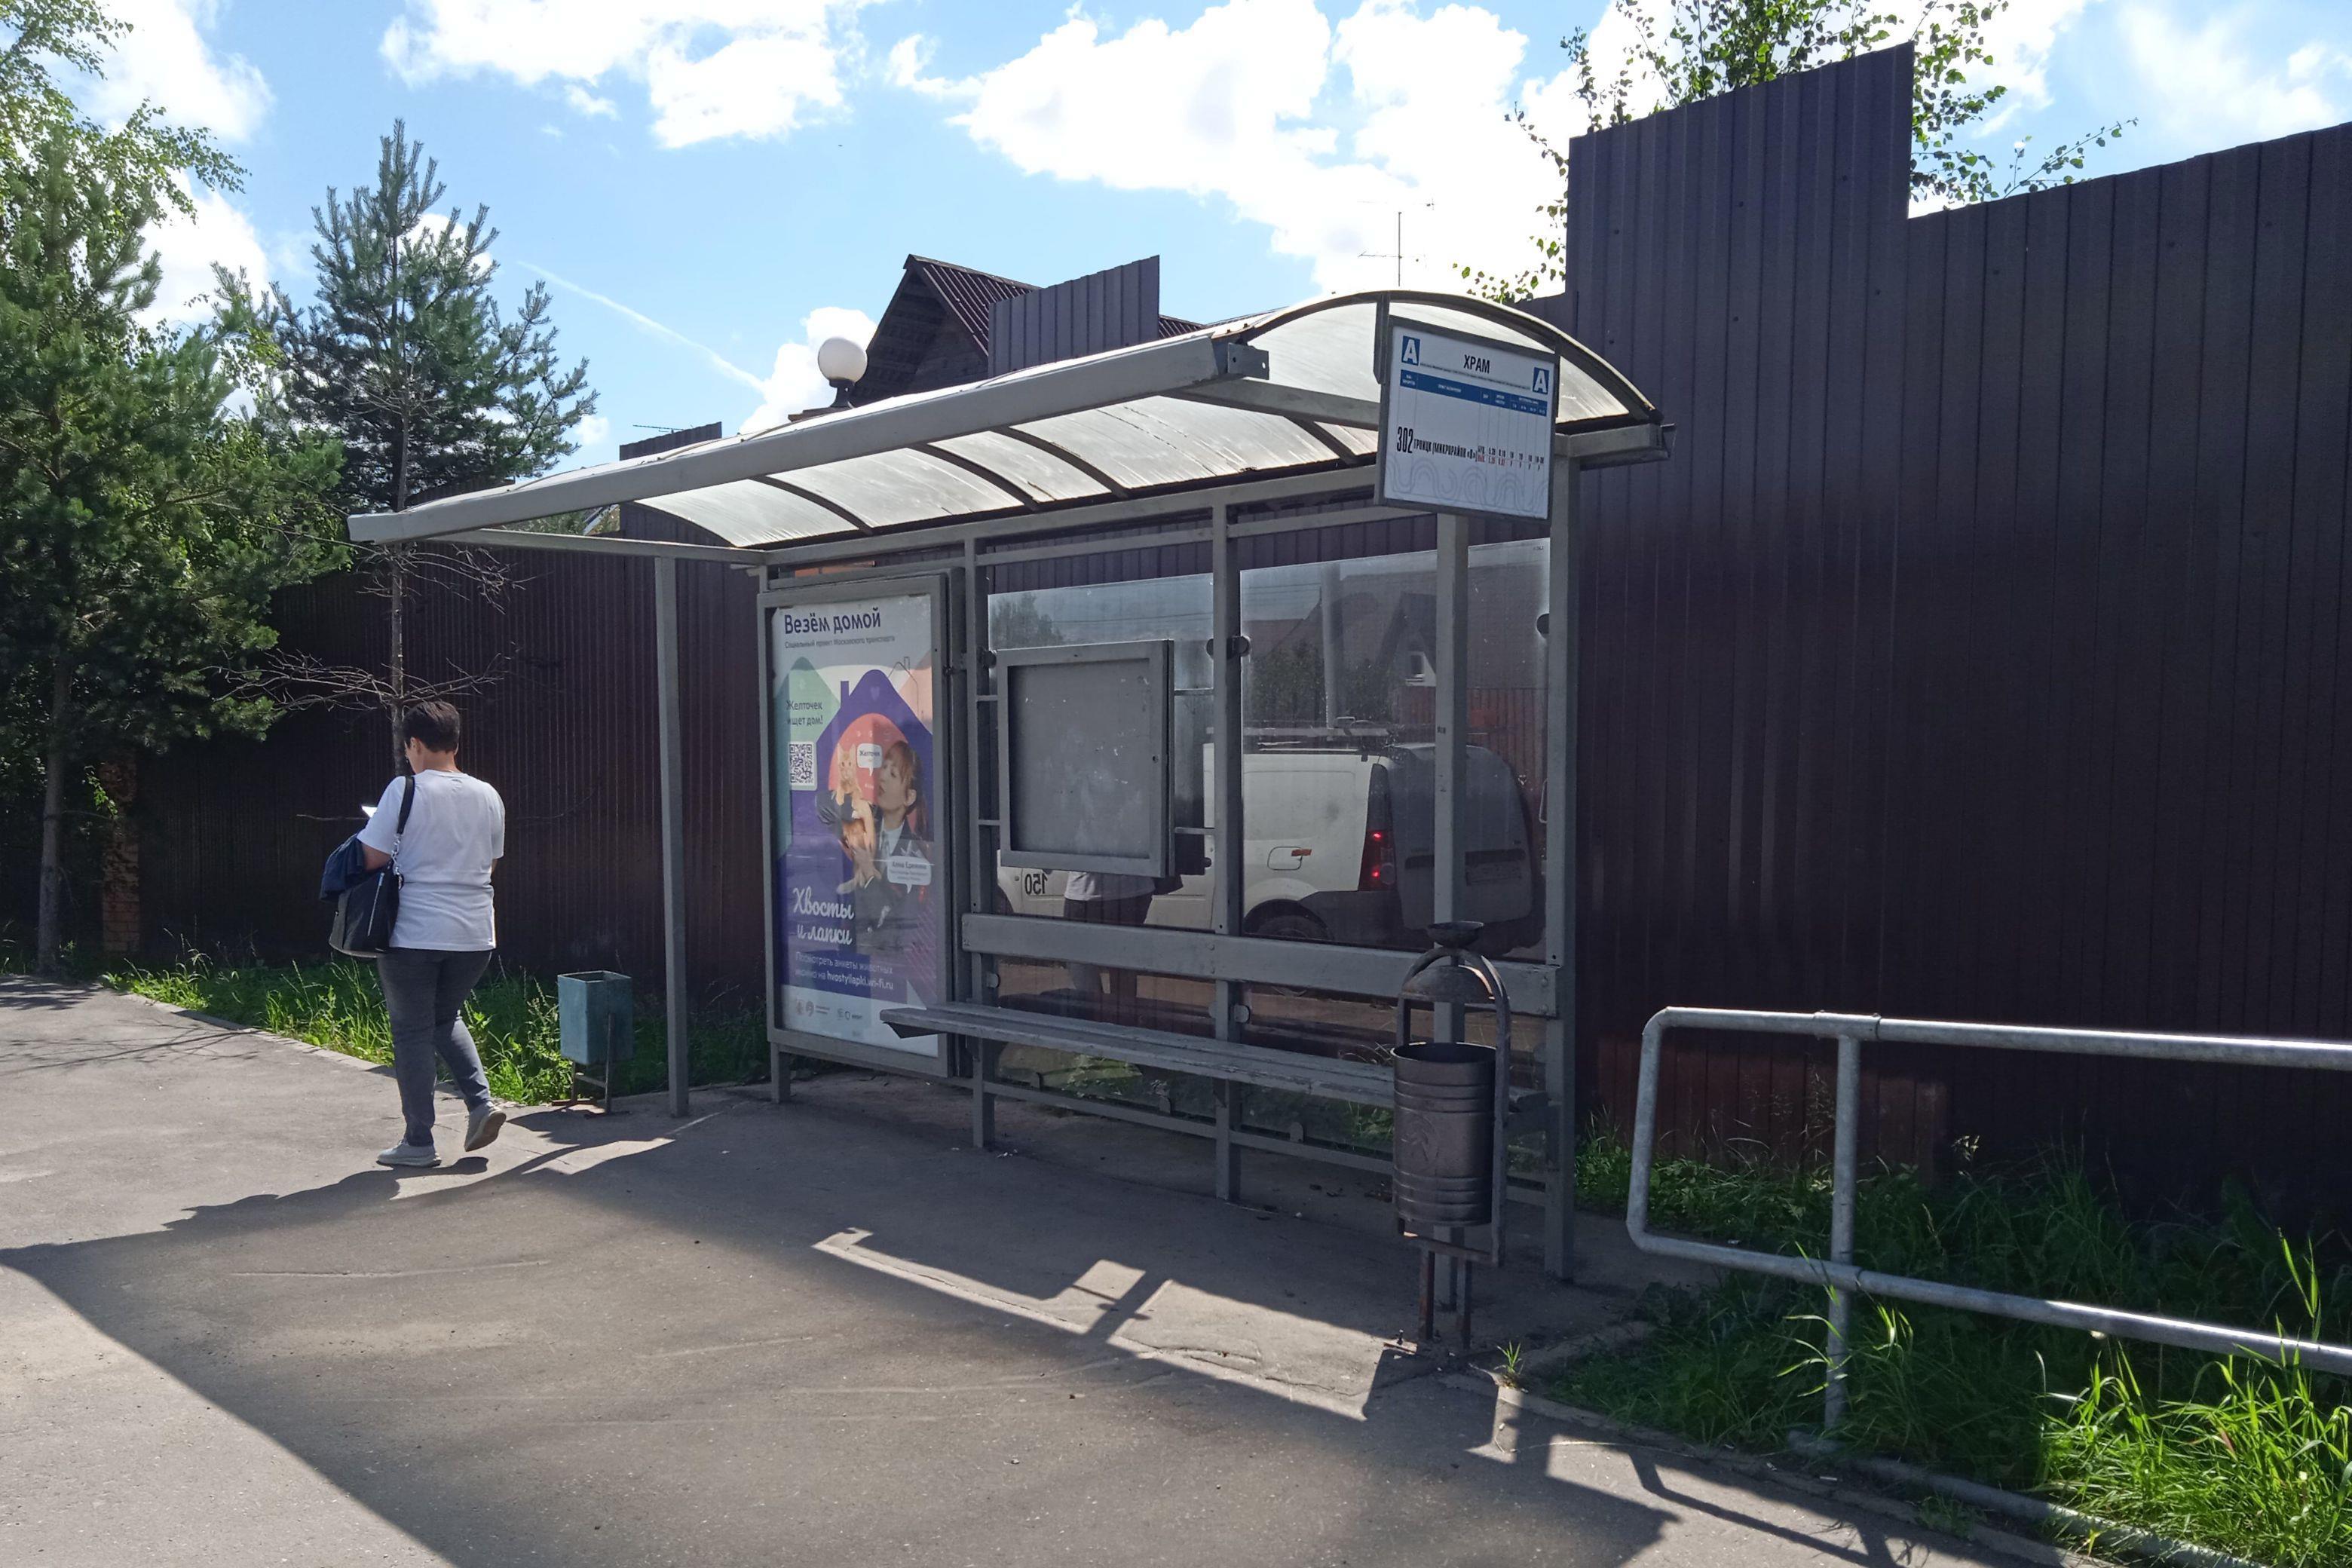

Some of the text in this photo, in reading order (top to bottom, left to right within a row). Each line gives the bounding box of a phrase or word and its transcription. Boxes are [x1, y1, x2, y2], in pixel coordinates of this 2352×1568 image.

[1463, 354, 1490, 374] ХРАМ
[1396, 426, 1414, 454] 302
[784, 607, 880, 634] Везём домой
[786, 700, 823, 711] Желточек
[807, 715, 824, 726] дом!
[793, 886, 855, 920] Хвосты
[807, 926, 853, 945] лапки
